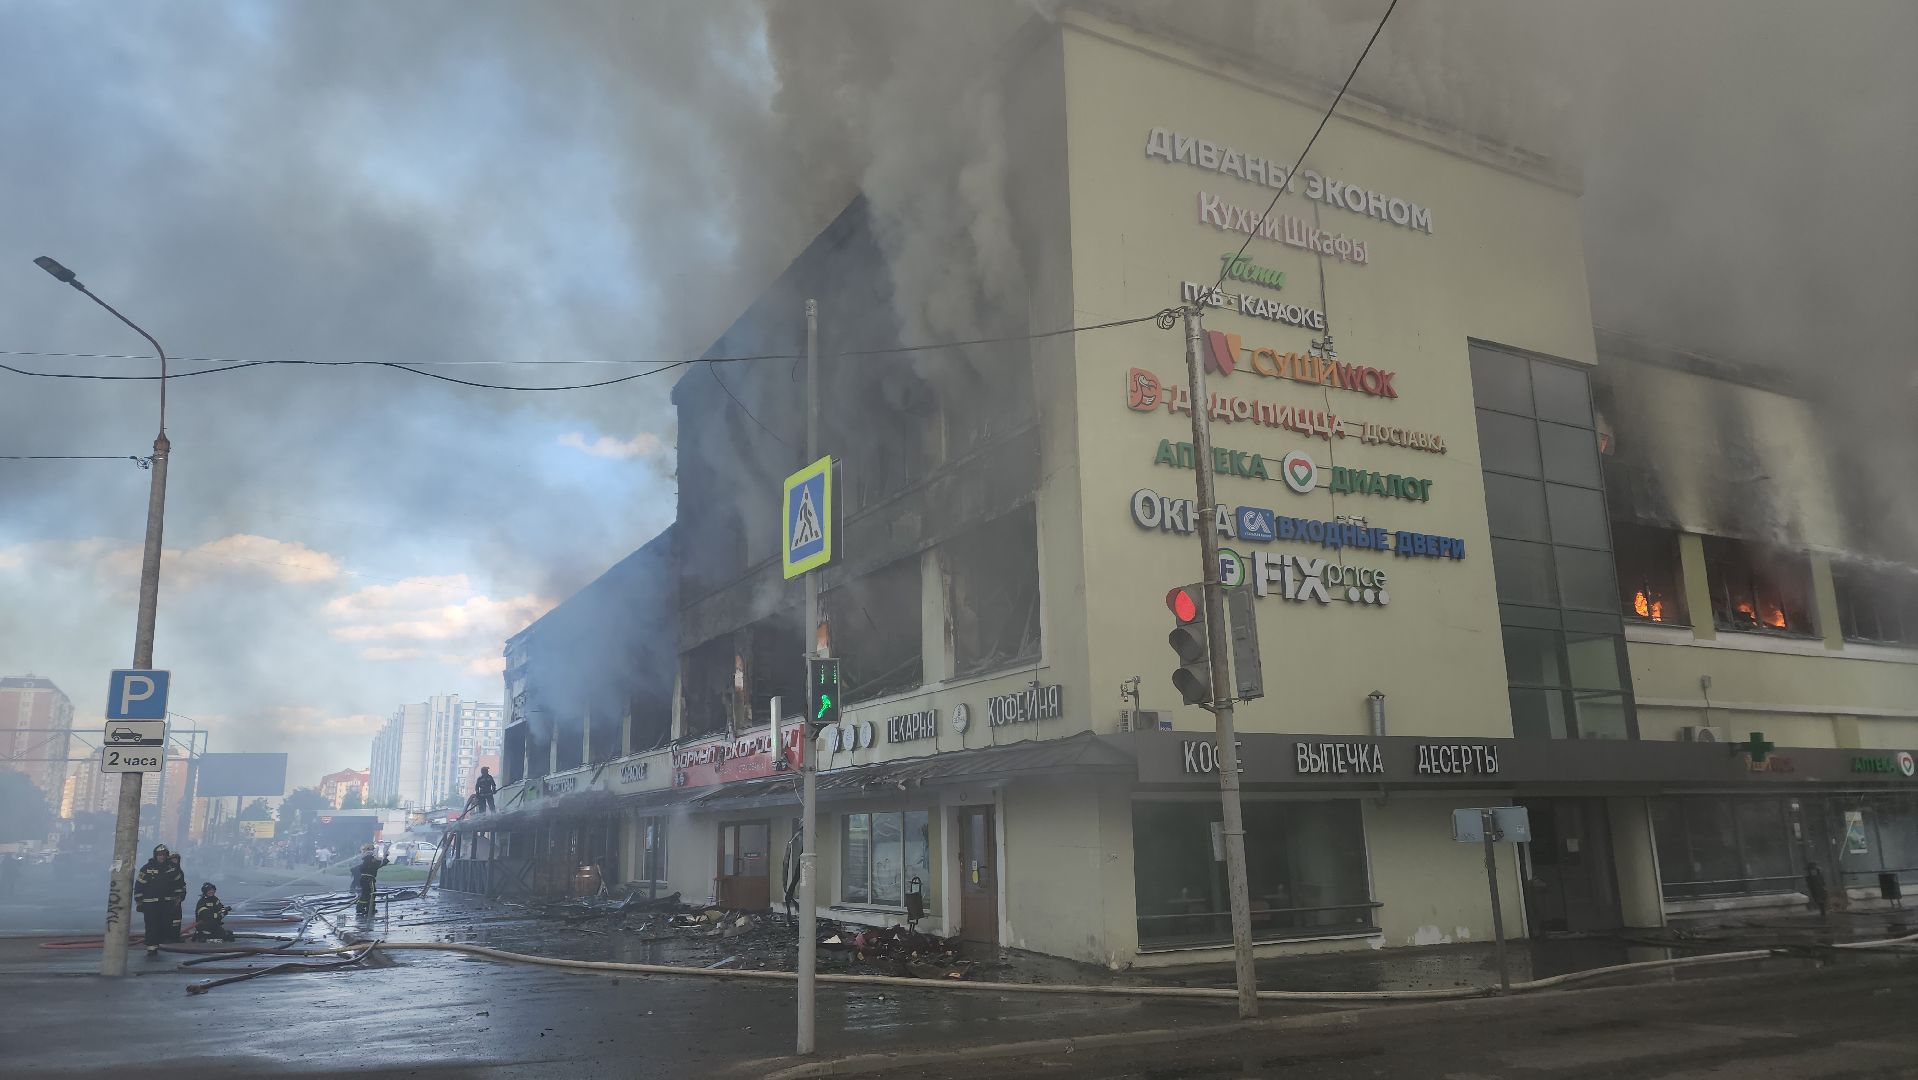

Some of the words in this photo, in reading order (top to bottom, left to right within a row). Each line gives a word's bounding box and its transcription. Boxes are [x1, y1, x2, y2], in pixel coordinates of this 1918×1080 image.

[1147, 127, 1296, 192] ДИВАНЫ
[1304, 169, 1434, 233] ЭКОНОМ
[1182, 281, 1224, 306] ПАБ
[1240, 293, 1325, 329] КАРАОКЕ
[1169, 384, 1251, 423] ДДО
[1255, 400, 1346, 439] ПИЦЦА
[1362, 422, 1447, 454] ДОСТАВКА
[1155, 439, 1269, 480] АПЕКА
[1330, 465, 1432, 502] ДИАЛОГ
[1276, 515, 1388, 550] ВХОДНЫЕ
[1395, 530, 1466, 559] ДВЕРИ
[1328, 563, 1387, 589] price
[120, 675, 155, 715] P
[988, 683, 1060, 726] КОФЕЙНЯ
[108, 751, 120, 766] 2
[123, 757, 157, 766] часа
[1297, 742, 1384, 773] ВЫПЕЧКА
[1418, 745, 1499, 774] ДЕСЕРТЫ
